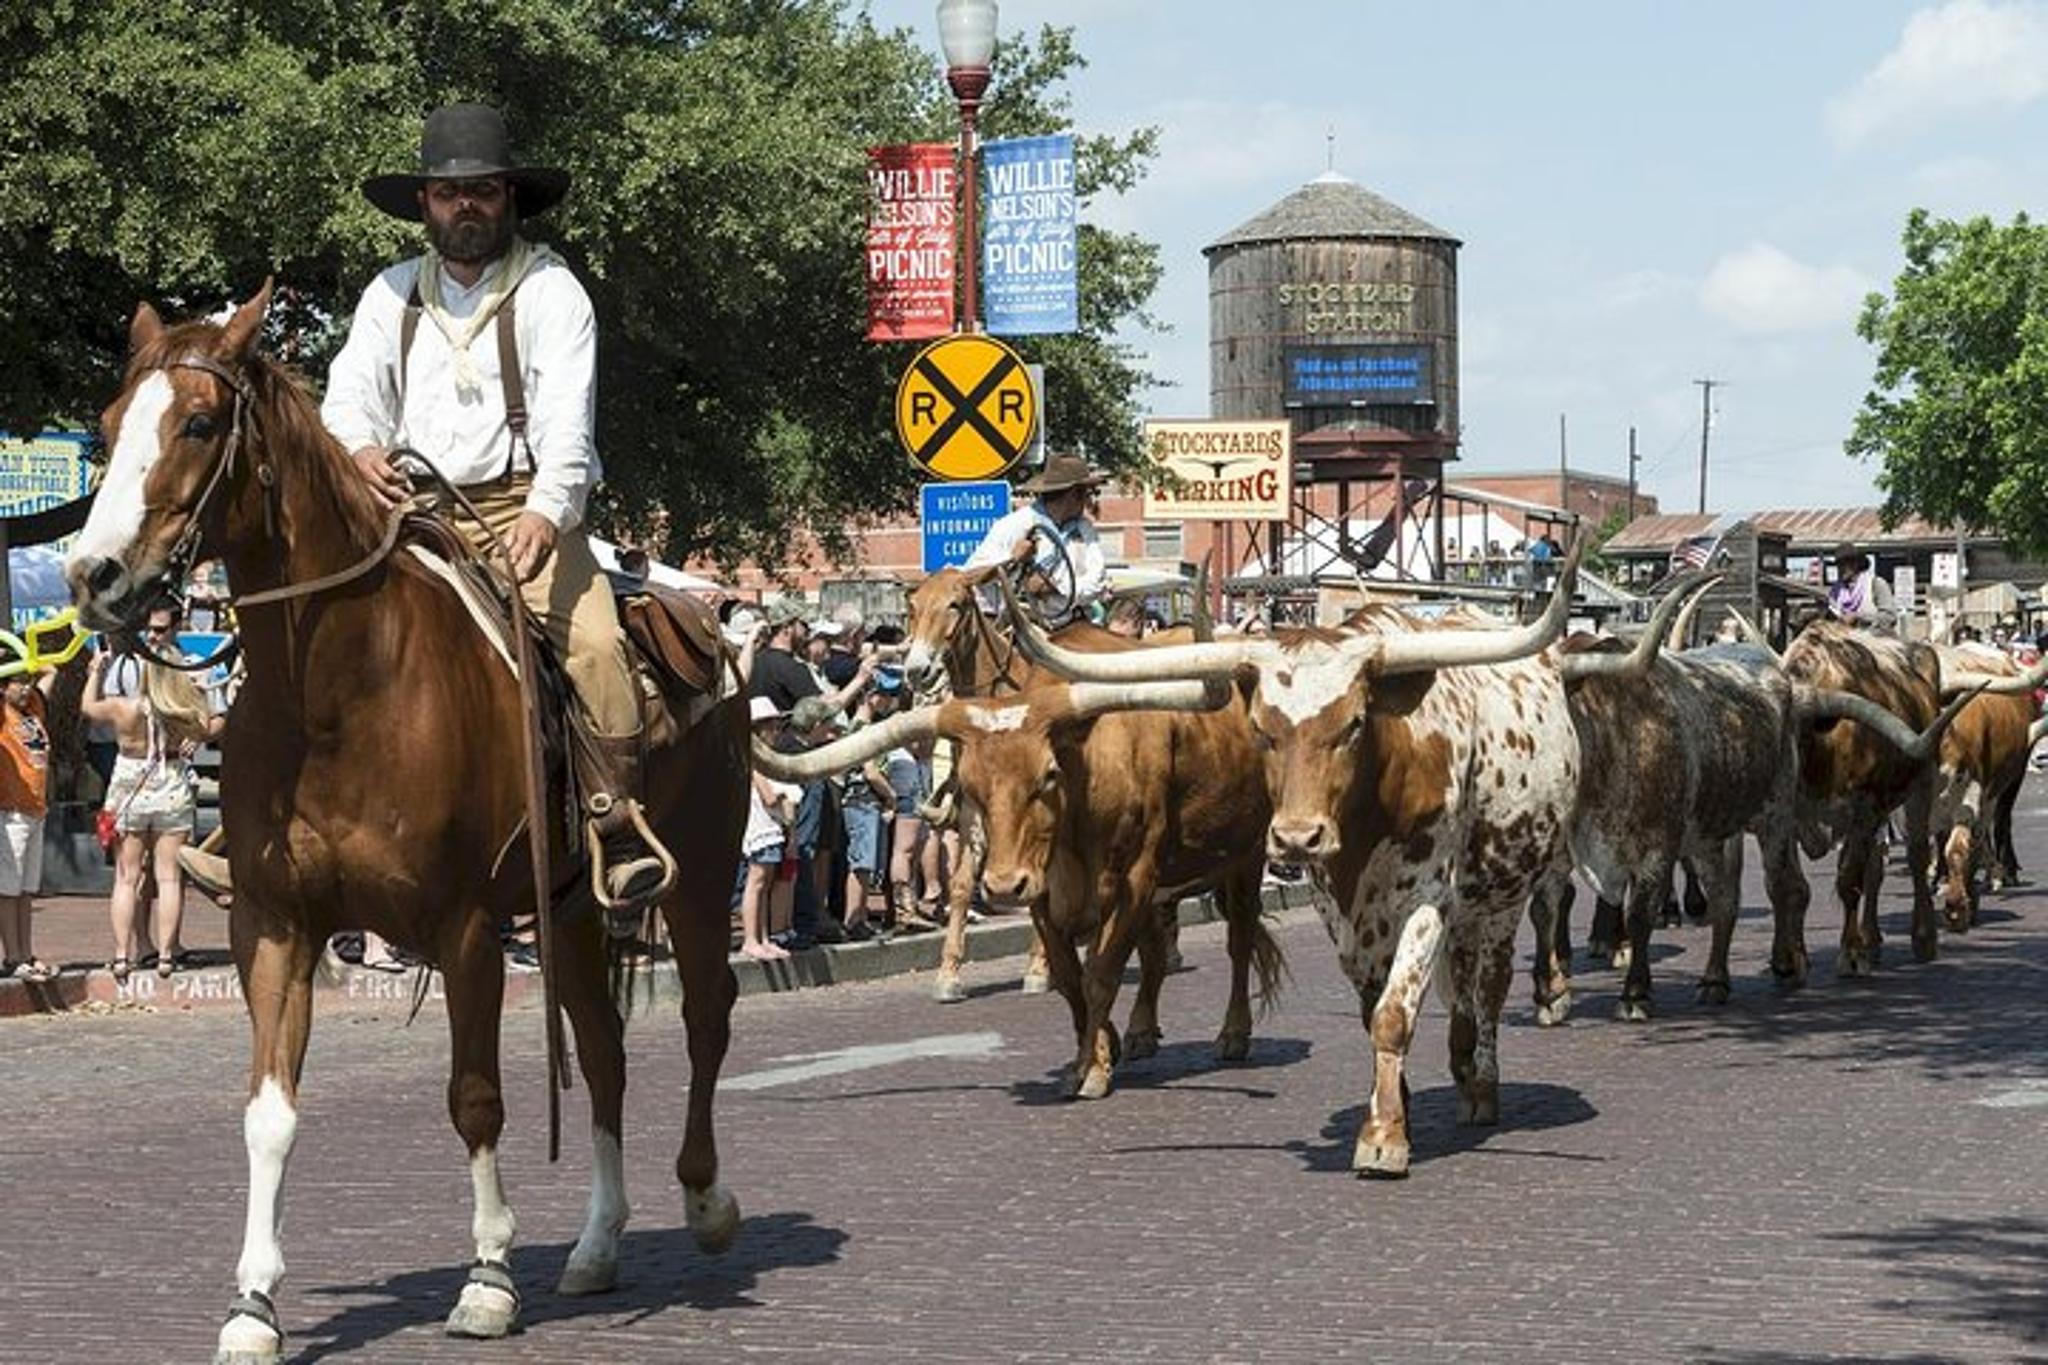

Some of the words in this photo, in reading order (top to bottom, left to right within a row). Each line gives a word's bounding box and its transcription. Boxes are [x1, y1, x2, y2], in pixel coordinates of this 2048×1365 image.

[867, 167, 954, 200] WILLIE
[987, 158, 1073, 196] WILLIE
[989, 193, 1073, 222] NELSON'S
[869, 249, 952, 281] PICNIC
[986, 240, 1074, 275] PICNIC
[1305, 311, 1402, 334] STATION
[911, 391, 937, 426] R
[1000, 388, 1025, 424] R
[1151, 428, 1283, 462] STOCKYARDS
[926, 518, 997, 535] INFORMATI
[943, 540, 981, 557] CENT
[117, 973, 156, 1000] NO
[172, 972, 241, 1001] PARK
